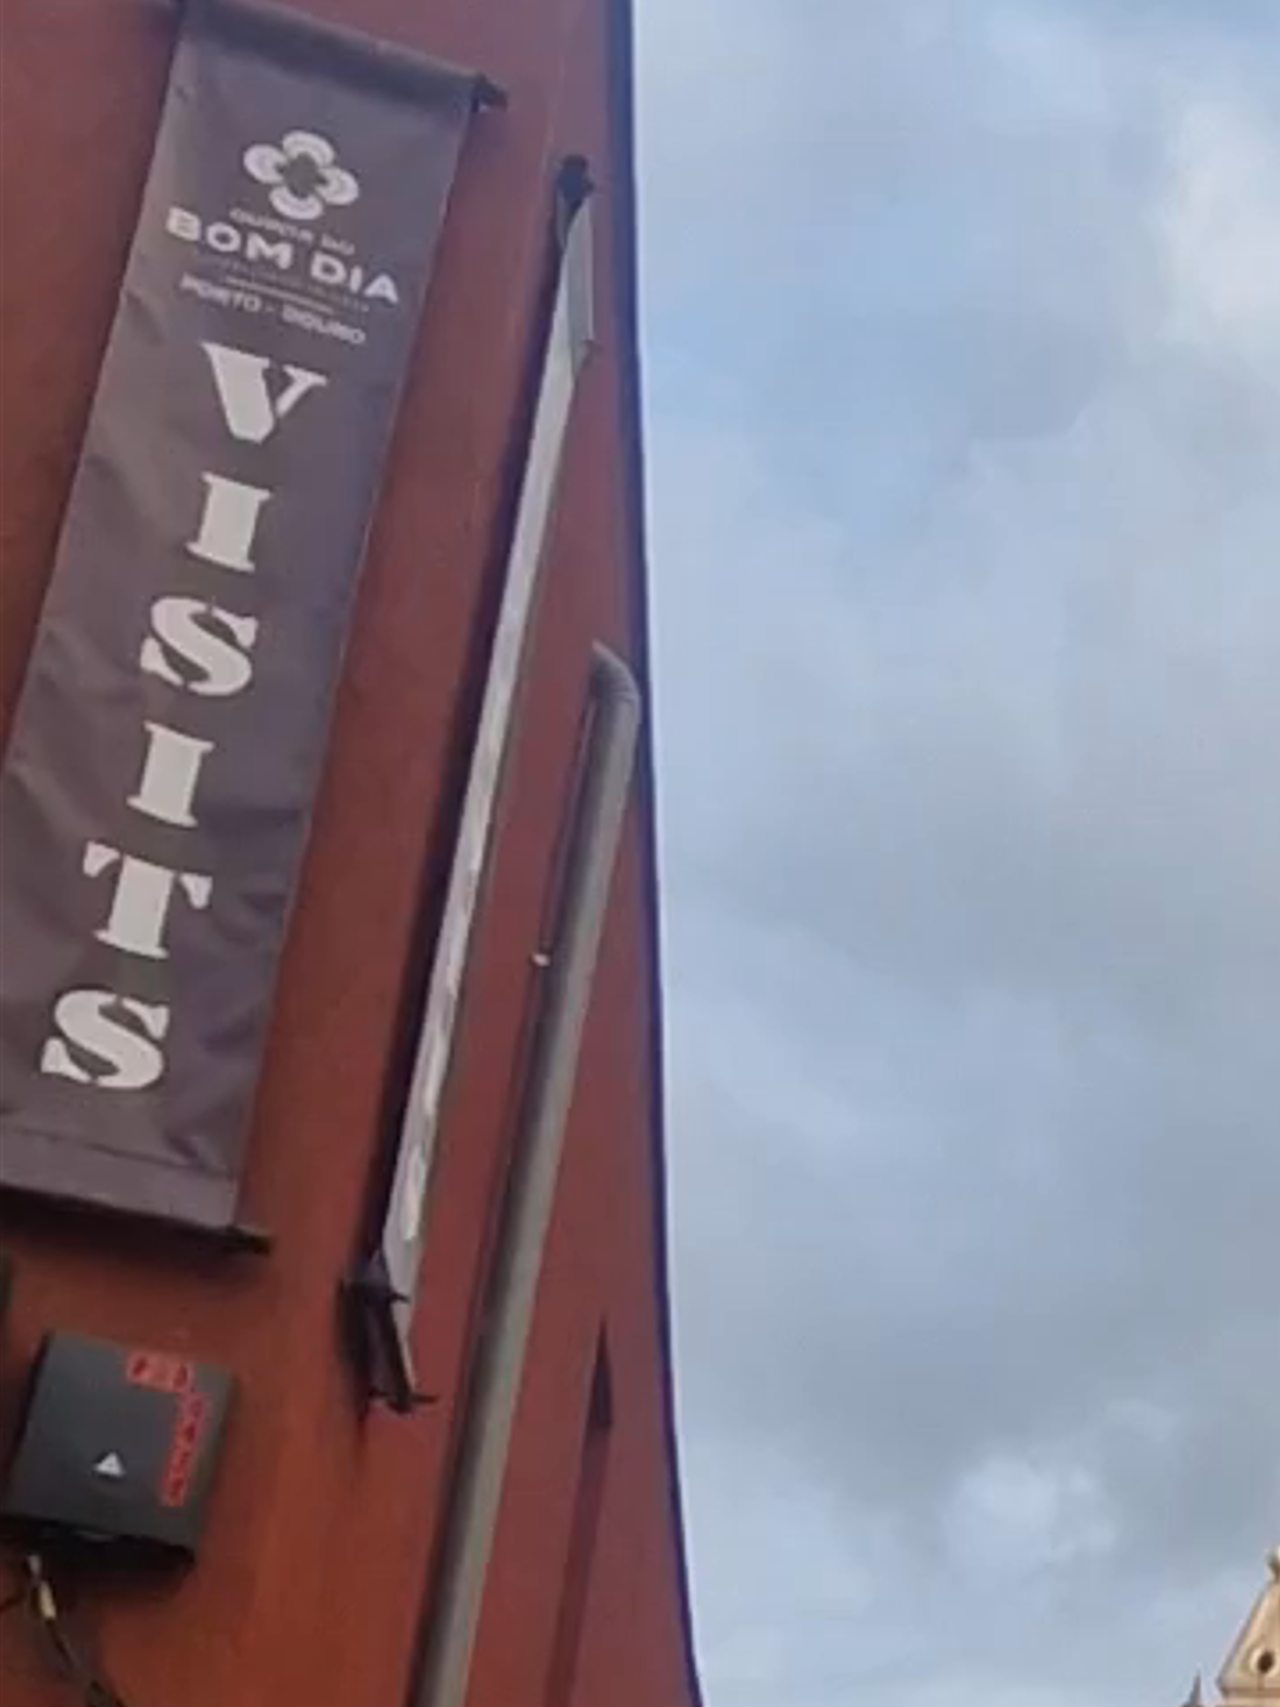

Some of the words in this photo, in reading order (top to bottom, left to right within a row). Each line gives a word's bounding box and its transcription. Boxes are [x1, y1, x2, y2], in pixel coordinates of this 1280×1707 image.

[165, 207, 294, 270] BOM
[310, 250, 399, 306] DIA
[180, 272, 262, 313] PORTO
[282, 303, 366, 344] DOURO
[40, 340, 328, 1092] VISITS
